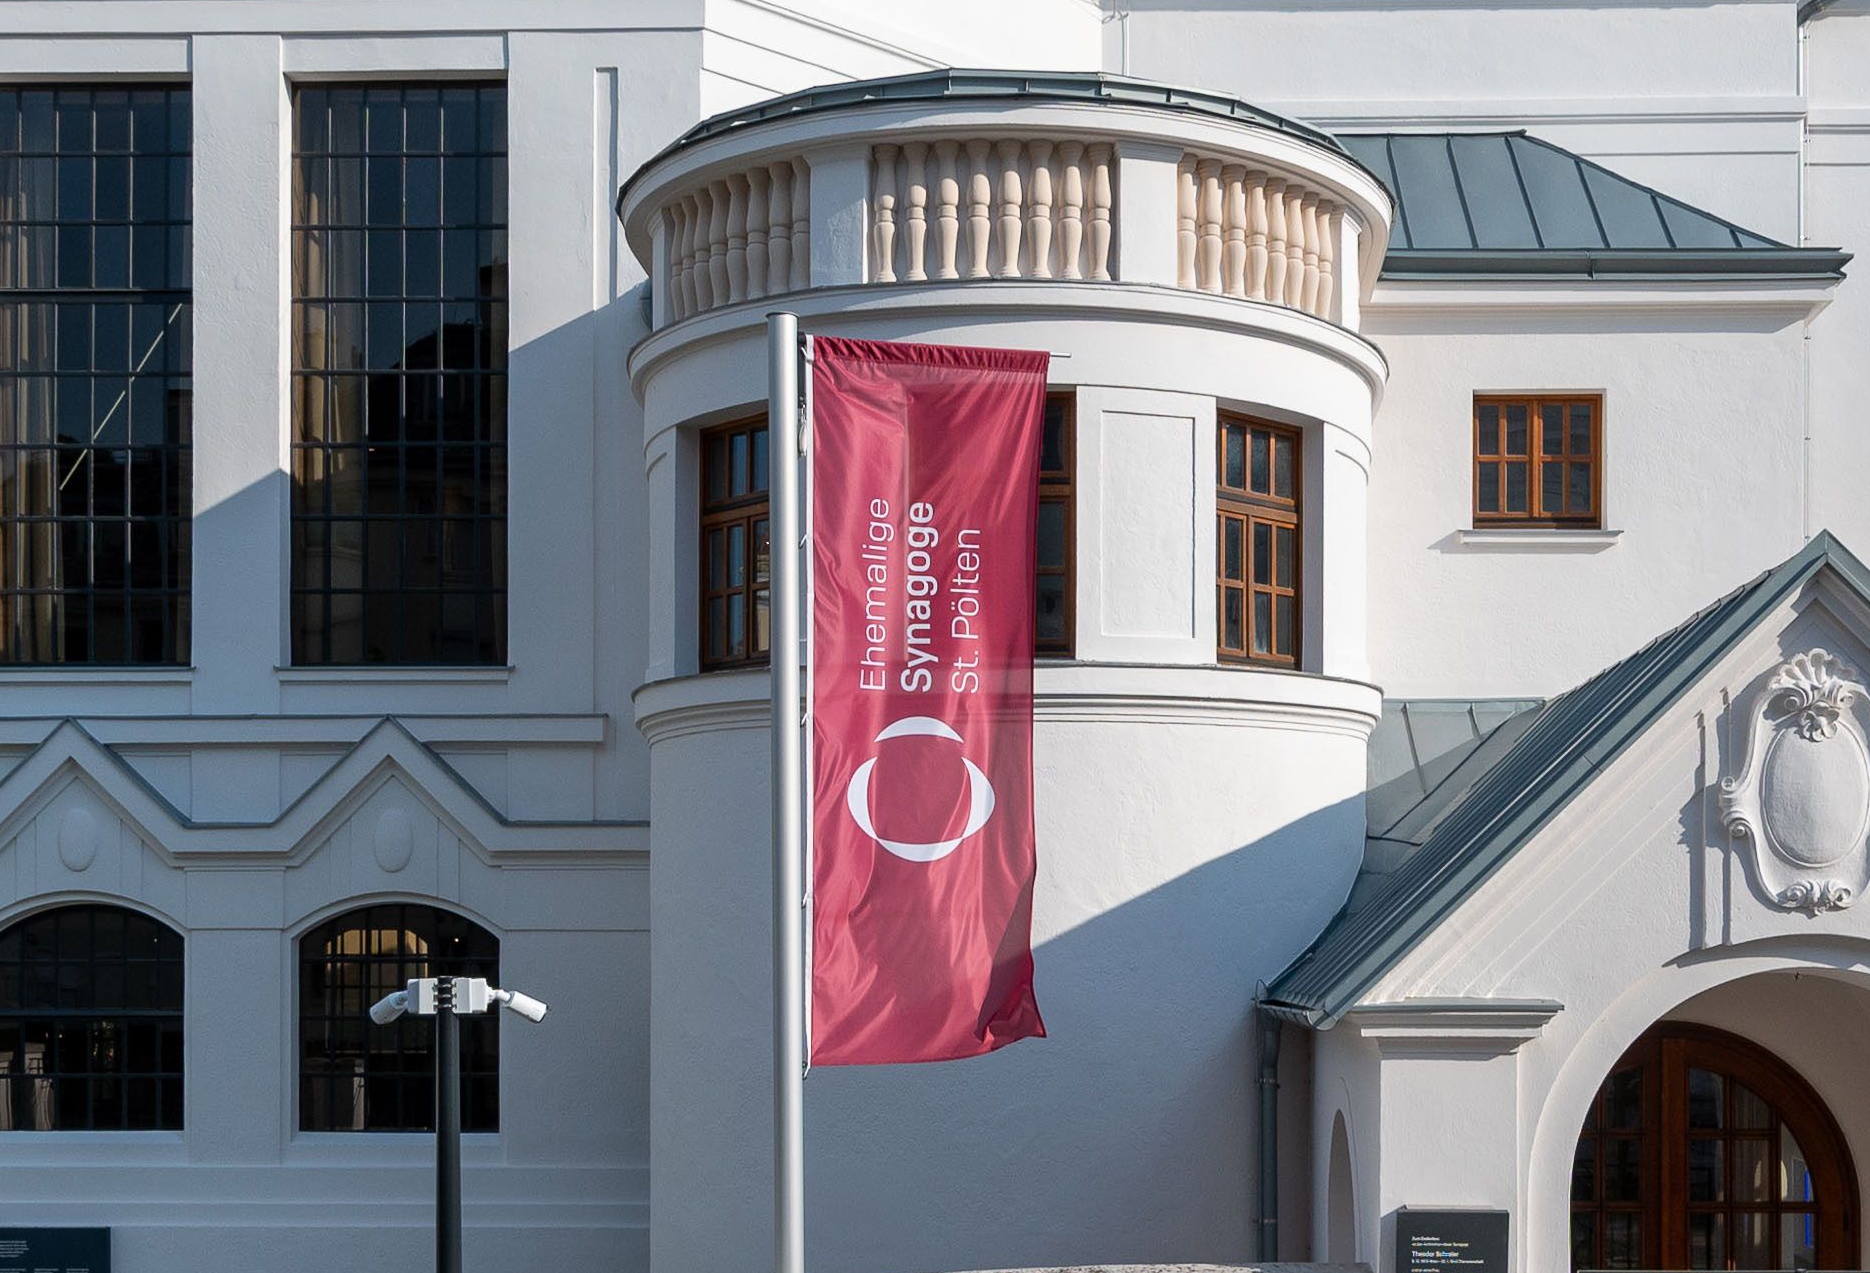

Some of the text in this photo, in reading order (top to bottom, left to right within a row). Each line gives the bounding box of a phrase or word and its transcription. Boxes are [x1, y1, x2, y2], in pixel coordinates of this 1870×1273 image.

[859, 498, 895, 691] Ehemalige
[900, 501, 938, 693] Synagoge
[949, 528, 981, 694] St. Pölten
